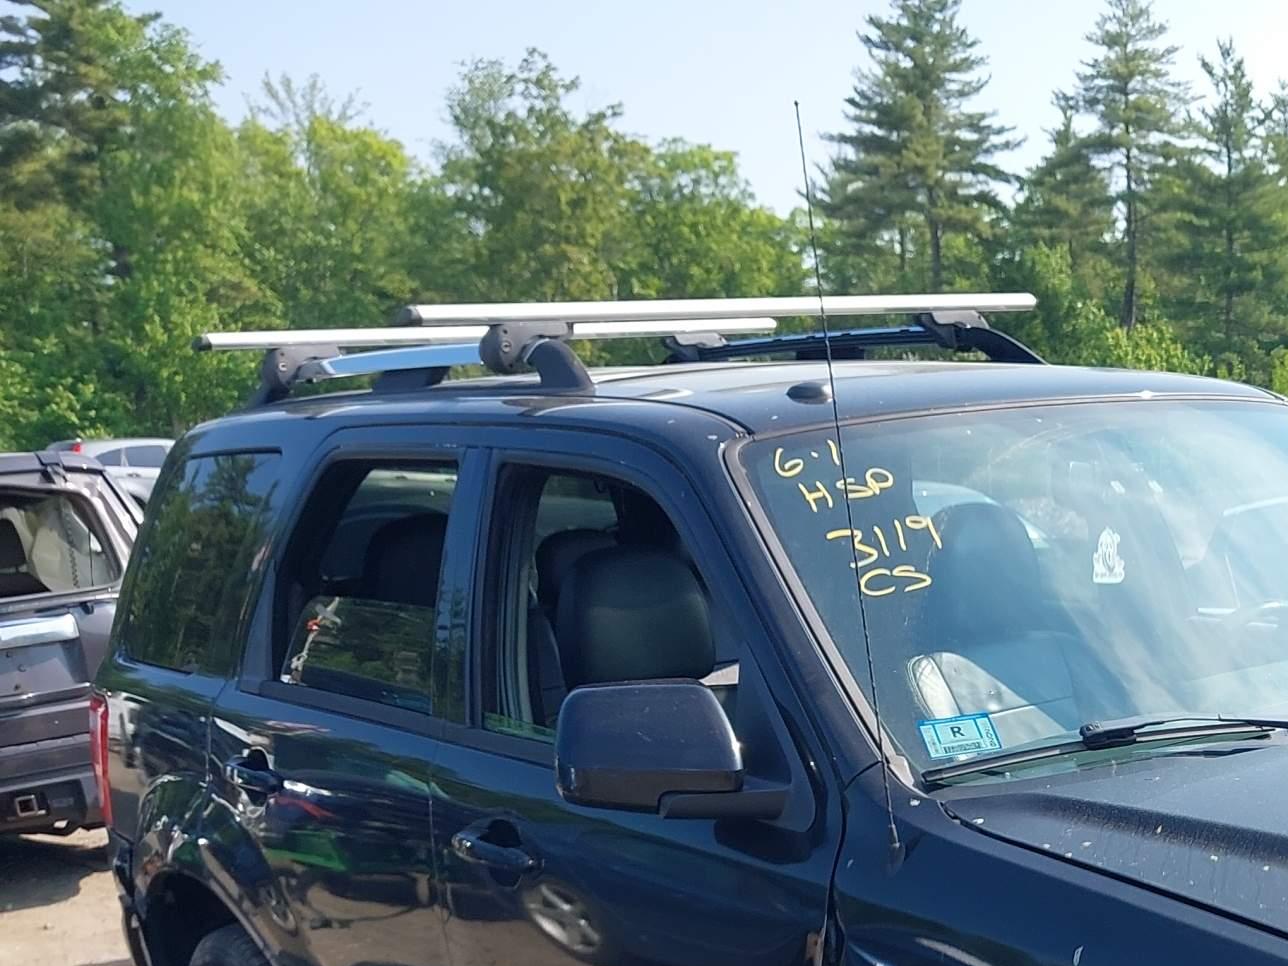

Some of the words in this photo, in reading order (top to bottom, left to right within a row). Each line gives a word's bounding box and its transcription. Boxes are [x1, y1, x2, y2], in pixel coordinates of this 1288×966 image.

[826, 514, 943, 568] 3119
[859, 565, 932, 596] CS
[950, 726, 965, 738] R
